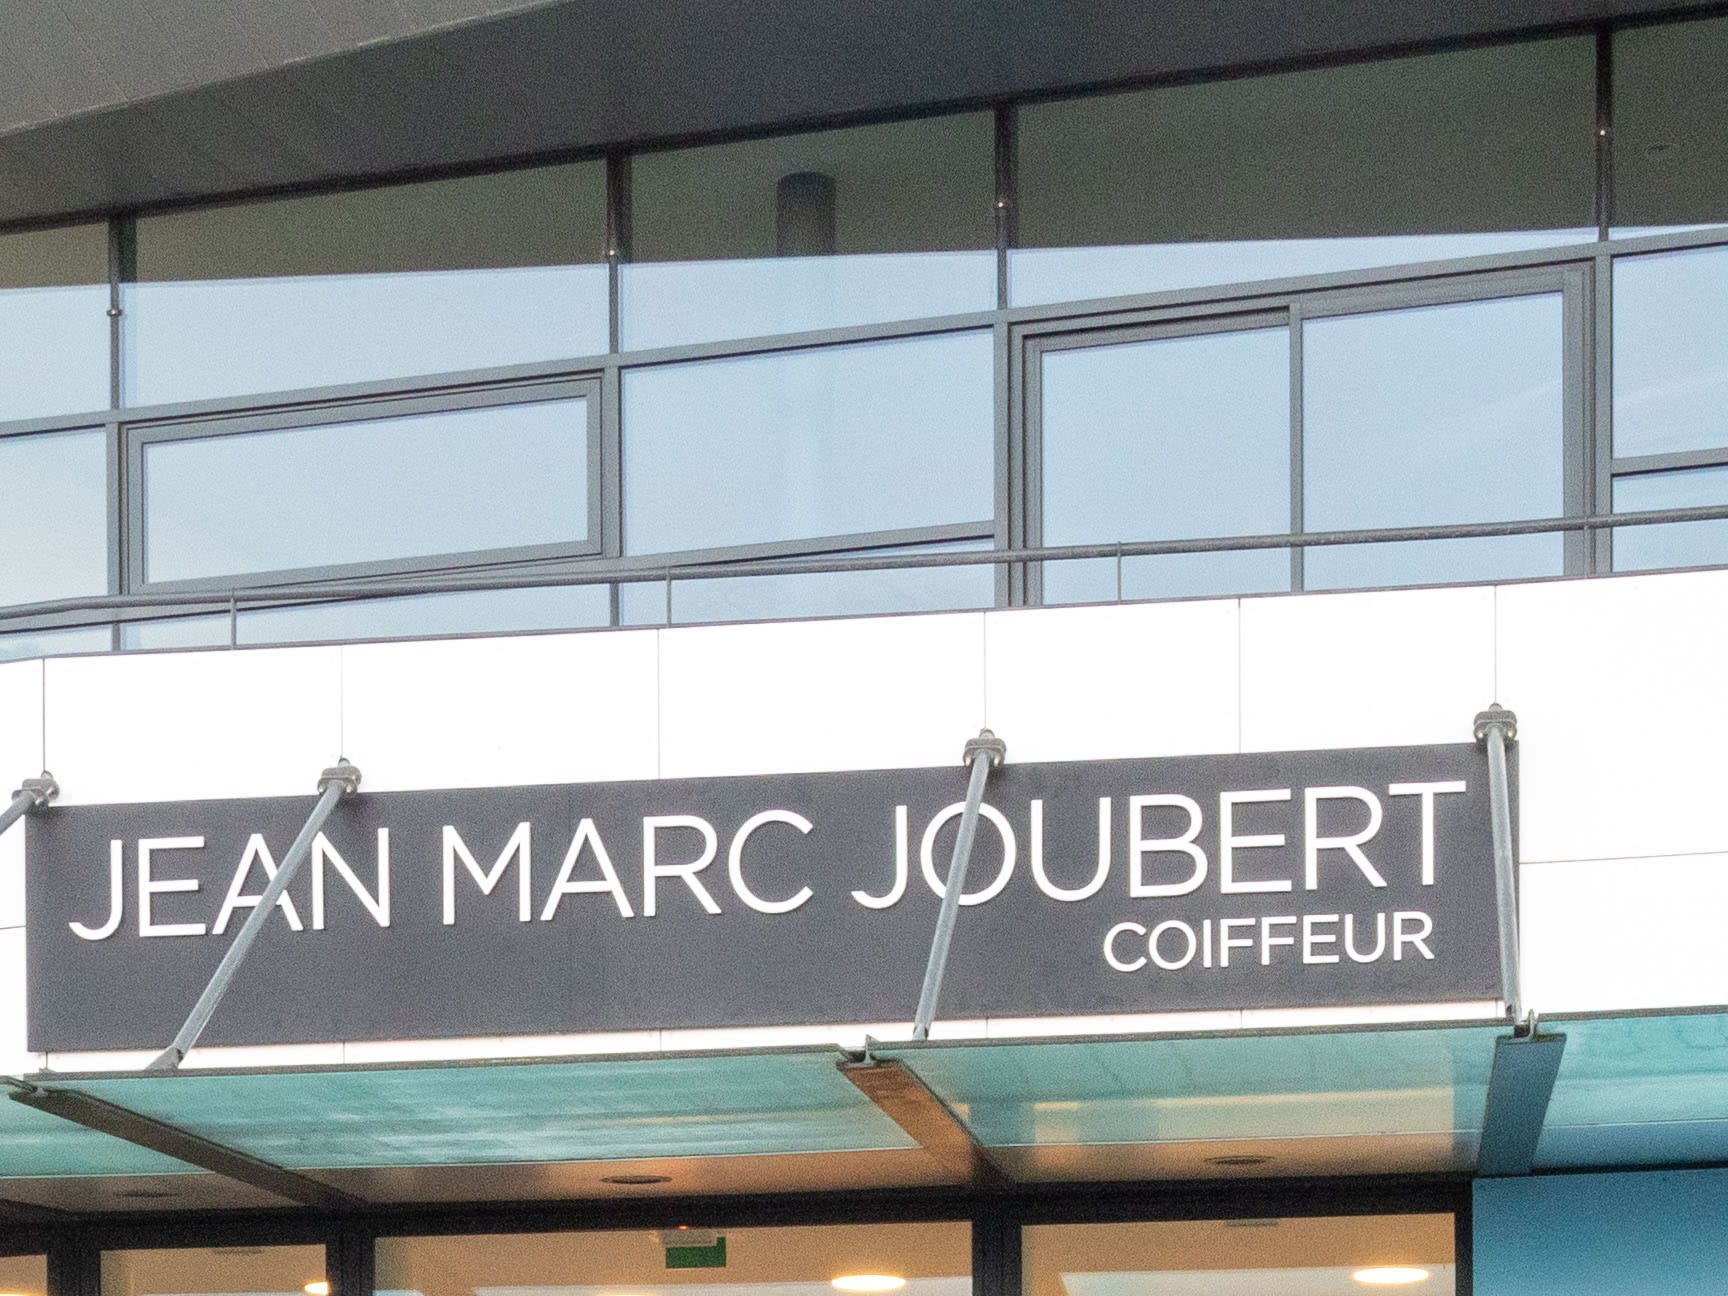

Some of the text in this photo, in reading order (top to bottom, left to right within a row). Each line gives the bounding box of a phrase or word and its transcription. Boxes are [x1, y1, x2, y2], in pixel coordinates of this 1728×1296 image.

[68, 780, 1467, 941] JEAN MARC JOUBERT
[1103, 911, 1436, 973] COIFFEUR
